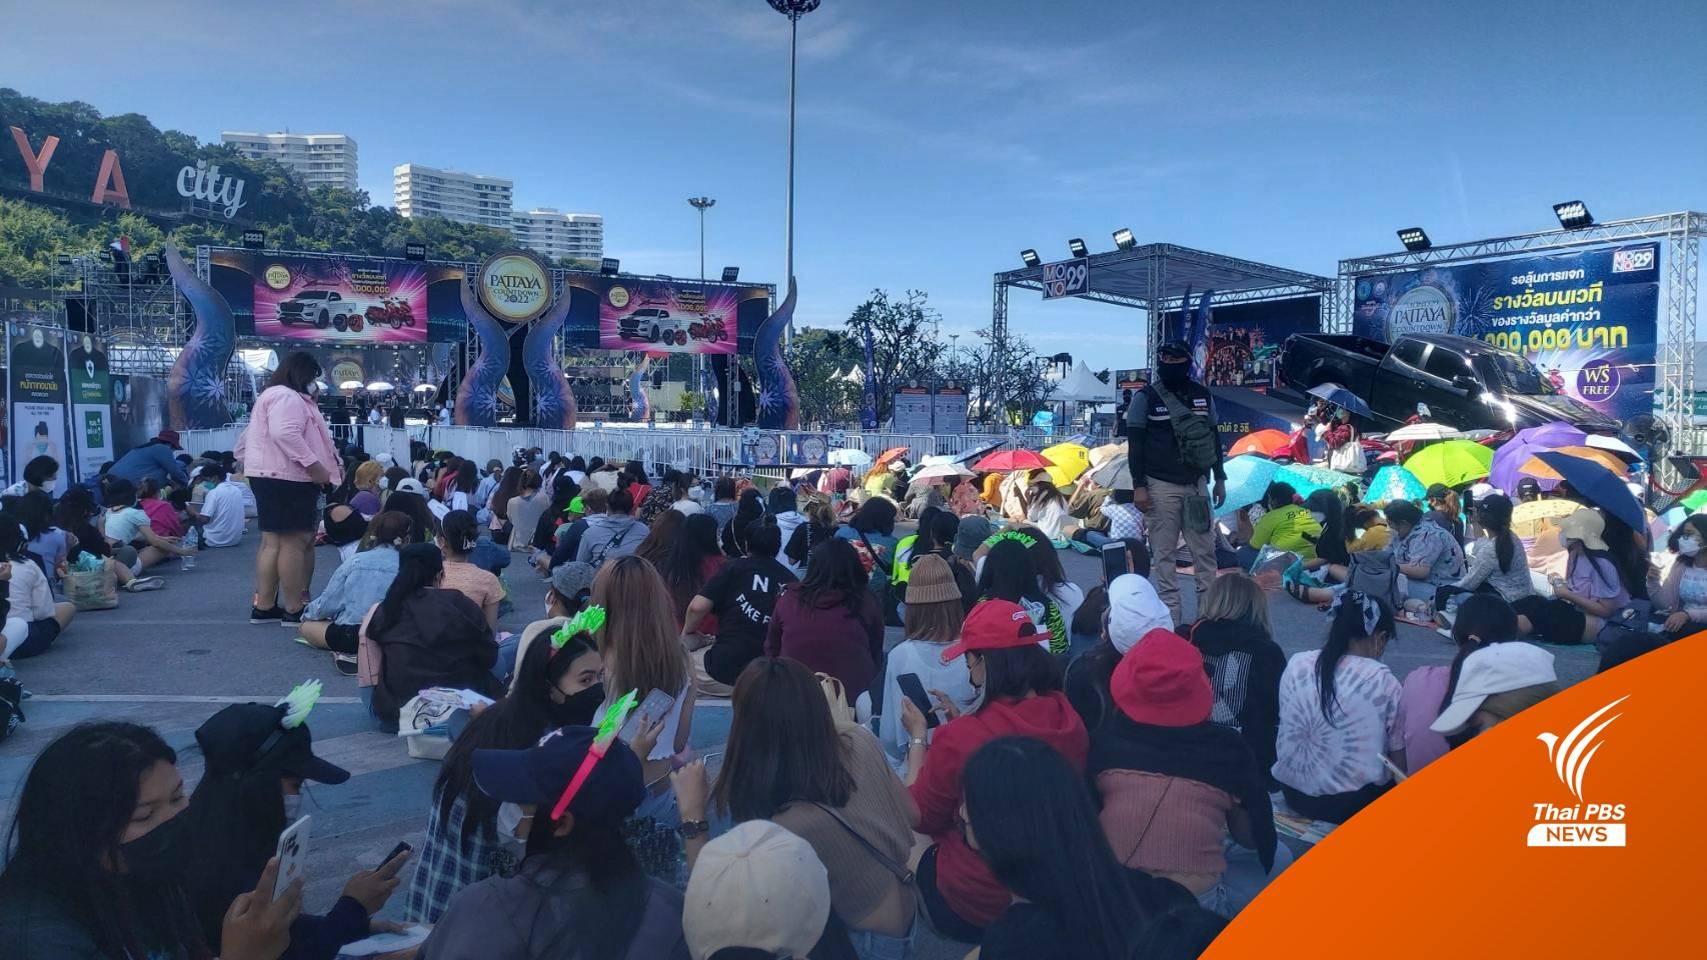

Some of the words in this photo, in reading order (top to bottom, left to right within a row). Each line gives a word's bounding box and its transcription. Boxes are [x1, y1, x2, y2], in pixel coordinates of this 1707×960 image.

[176, 159, 247, 219] city
[490, 274, 542, 289] PATTAYA
[1511, 268, 1585, 287] รอลุ้นการแจก
[493, 288, 539, 296] COUNTDOWN
[1493, 281, 1604, 310] รางวัลบนเวที
[1395, 307, 1447, 325] PATTAYA
[1491, 307, 1601, 328] ของรางวัลมูลค่ากว่า
[1576, 324, 1628, 350] บาท
[1583, 385, 1610, 395] FREE
[736, 593, 761, 622] FAKE
